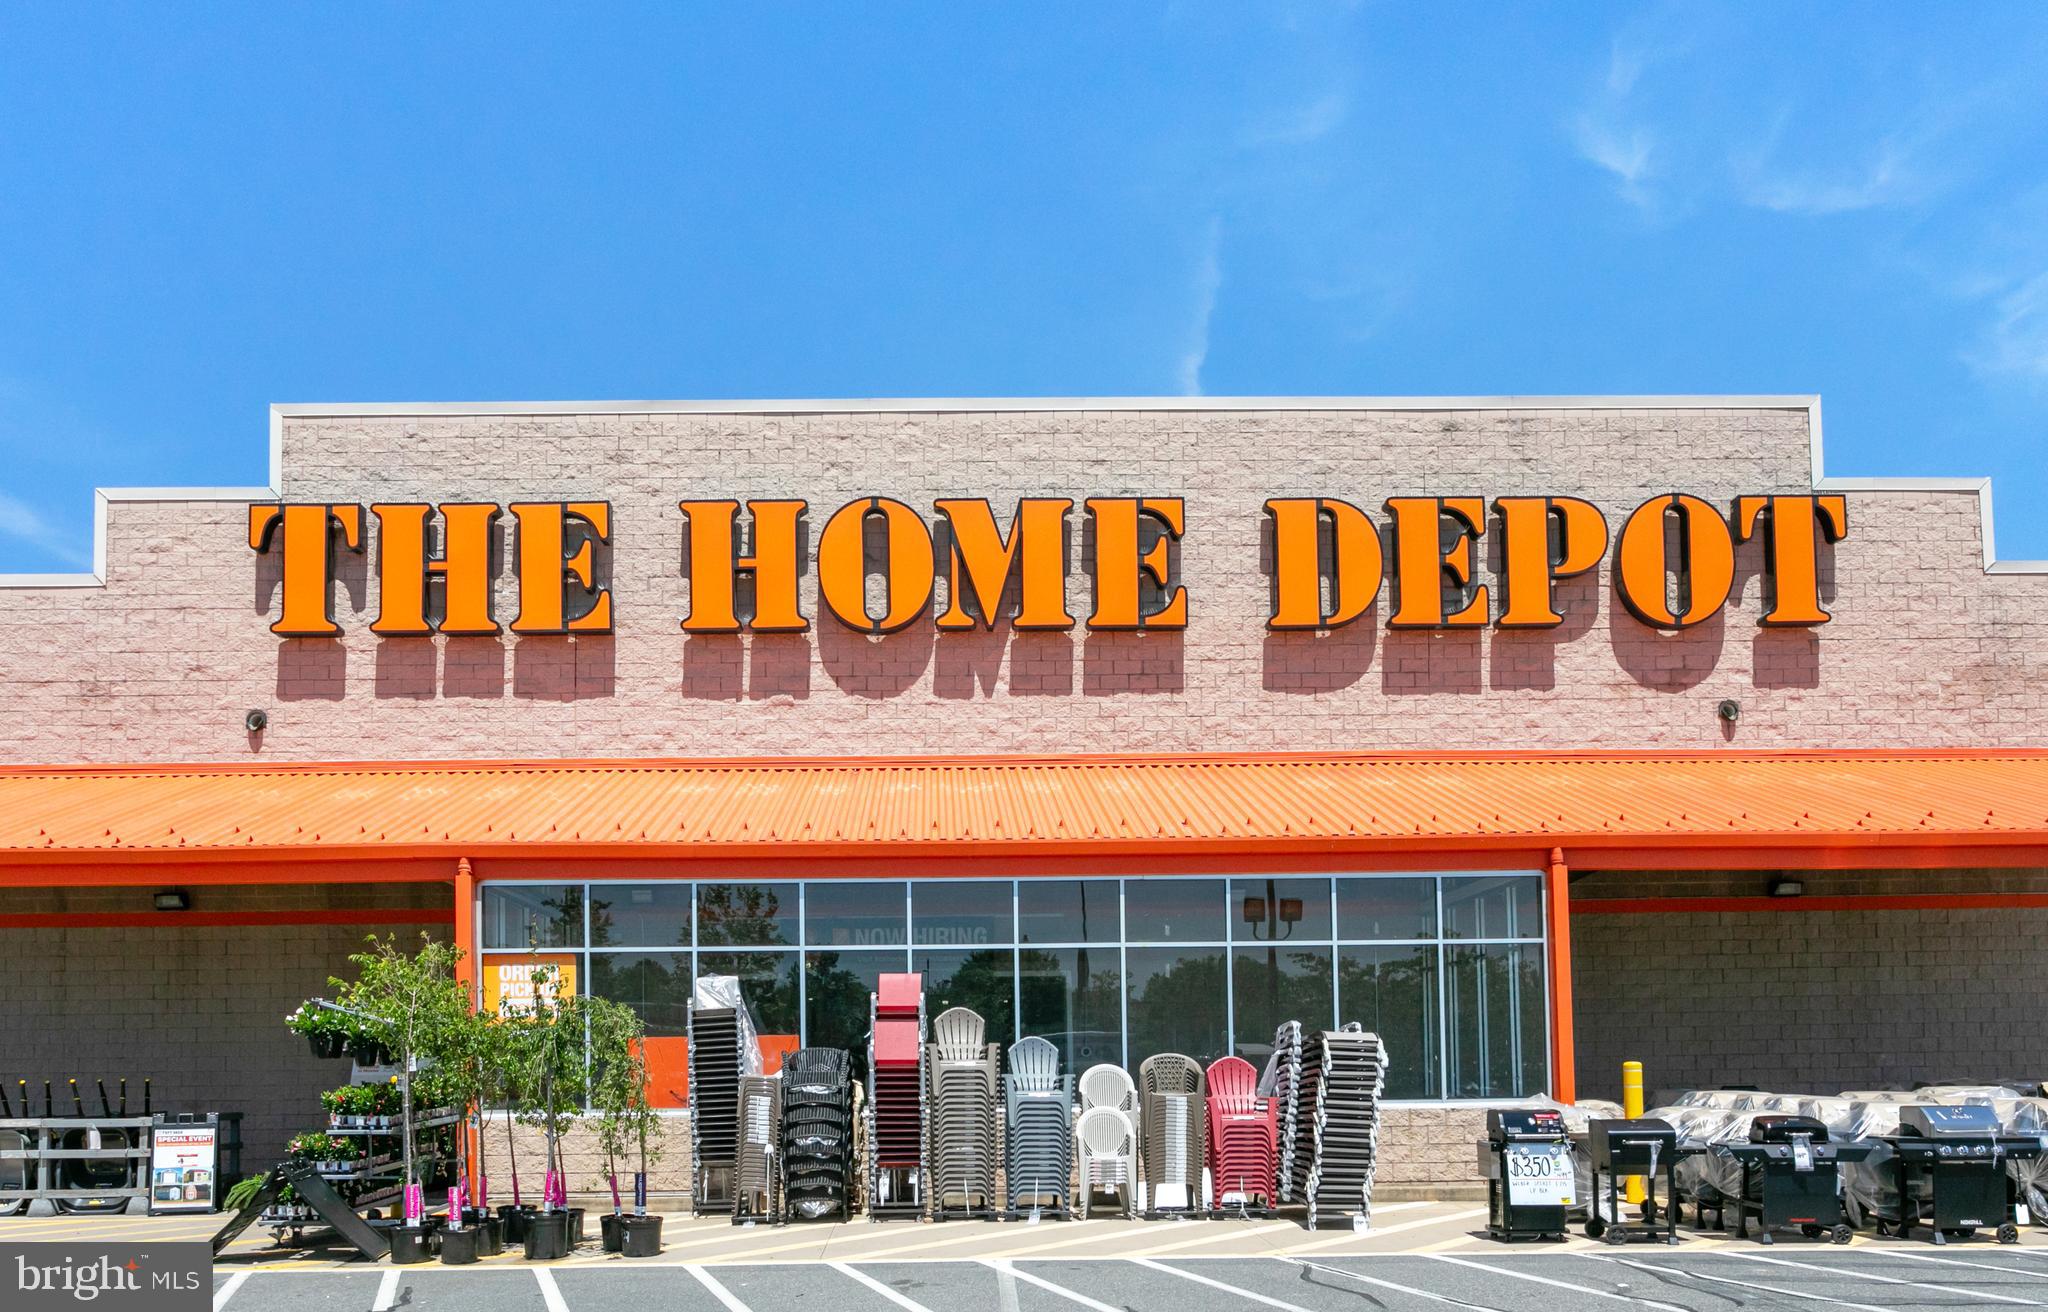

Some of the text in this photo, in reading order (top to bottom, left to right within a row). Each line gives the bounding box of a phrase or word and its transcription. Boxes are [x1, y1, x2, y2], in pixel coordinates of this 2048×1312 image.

[249, 493, 1848, 636] THE HOME DEPOT
[855, 926, 988, 945] NOW HIRING
[1510, 1156, 1551, 1177] $350
